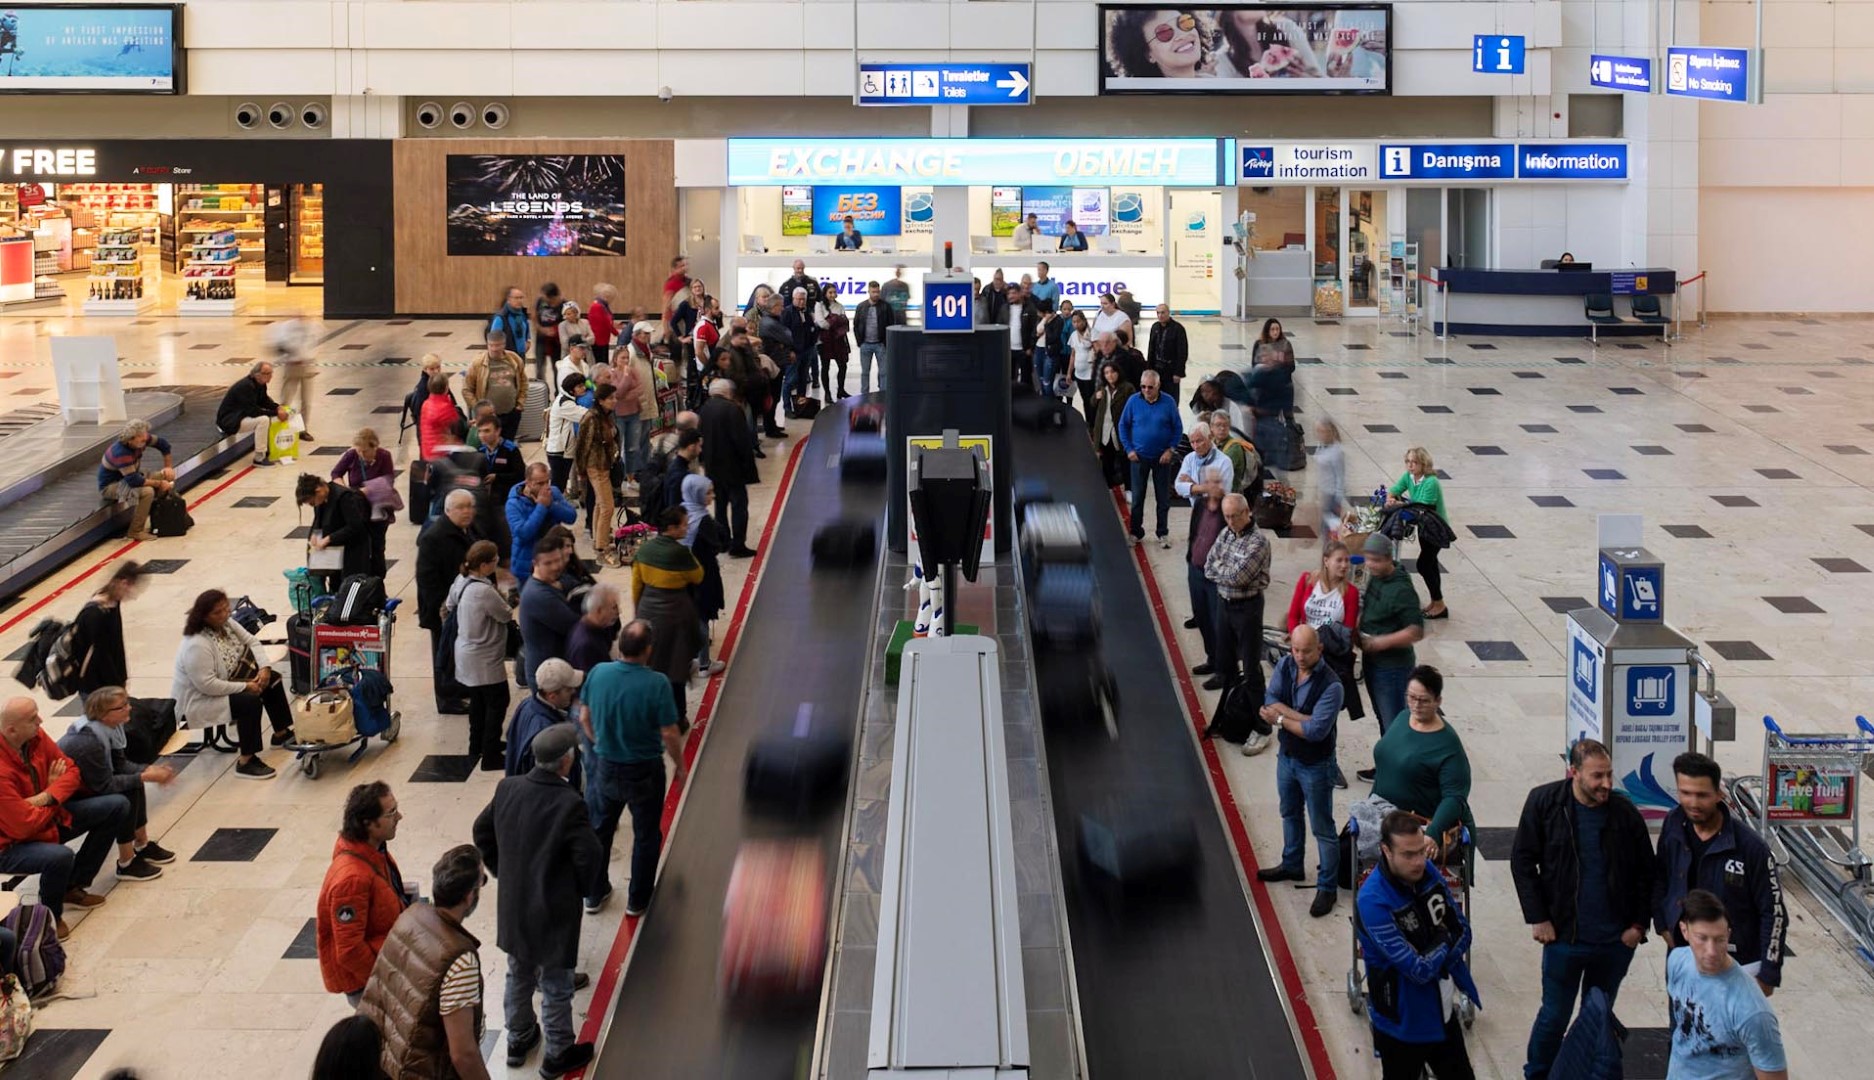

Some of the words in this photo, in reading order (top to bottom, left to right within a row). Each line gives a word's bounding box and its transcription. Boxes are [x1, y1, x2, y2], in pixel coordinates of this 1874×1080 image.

[942, 86, 967, 98] Toilets
[1688, 77, 1700, 90] No
[1700, 78, 1733, 95] Smoking
[12, 148, 97, 175] FREE
[767, 147, 965, 177] EXCHANGE
[1053, 147, 1181, 177] ОБМЕН
[1294, 147, 1353, 161] tourism
[1422, 152, 1501, 172] Danışma
[1525, 153, 1620, 170] Information
[1279, 164, 1368, 178] information
[490, 201, 583, 213] LEGENDS
[837, 192, 879, 214] БЕЗ
[932, 295, 967, 318] 101
[1779, 781, 1814, 798] Have
[1816, 780, 1845, 798] fun!
